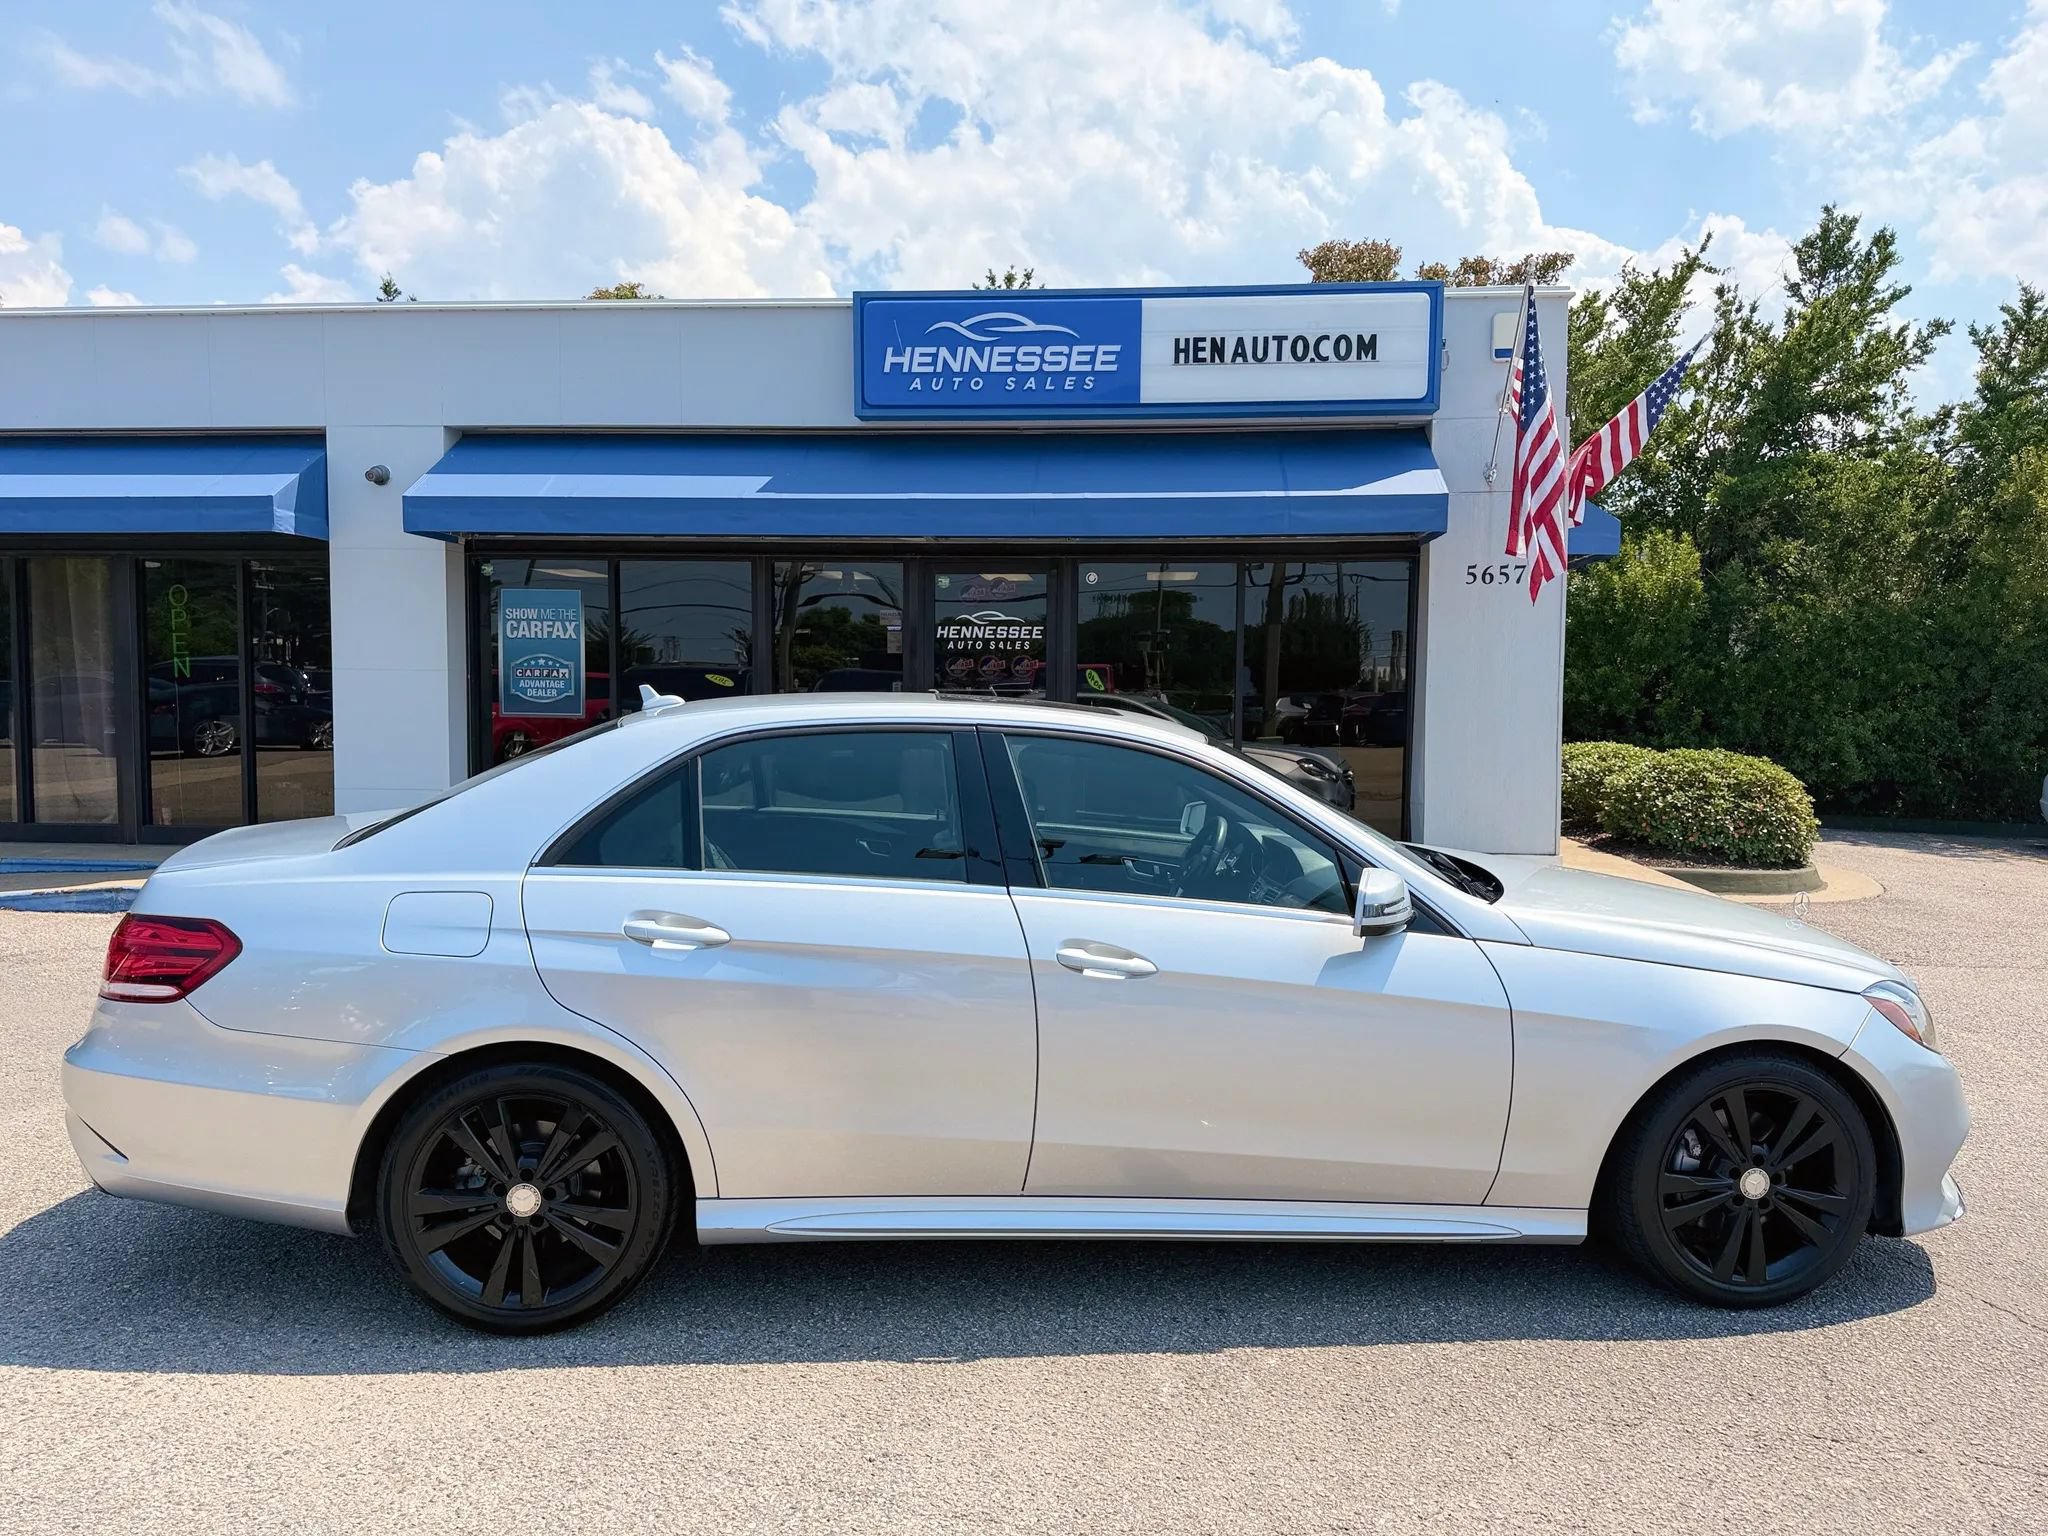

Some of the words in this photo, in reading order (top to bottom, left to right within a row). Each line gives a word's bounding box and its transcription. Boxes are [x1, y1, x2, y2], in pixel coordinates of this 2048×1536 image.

[1174, 334, 1377, 364] HENAUTO.COM
[883, 345, 1121, 373] HENNESSEE
[909, 377, 984, 391] AUTO
[1005, 376, 1095, 390] SALES
[1465, 564, 1527, 585] 5657
[505, 608, 538, 620] SHOW
[540, 609, 556, 620] ME
[558, 609, 577, 620] THE
[169, 584, 190, 678] OPEN
[506, 620, 577, 639] CARFAX
[936, 626, 1044, 639] HENNESSEE
[947, 641, 983, 650] AUTO
[989, 641, 1031, 650] SALES
[516, 669, 569, 678] CARFAX
[519, 680, 565, 688] ADVANTAGE
[527, 689, 558, 697] DEALER
